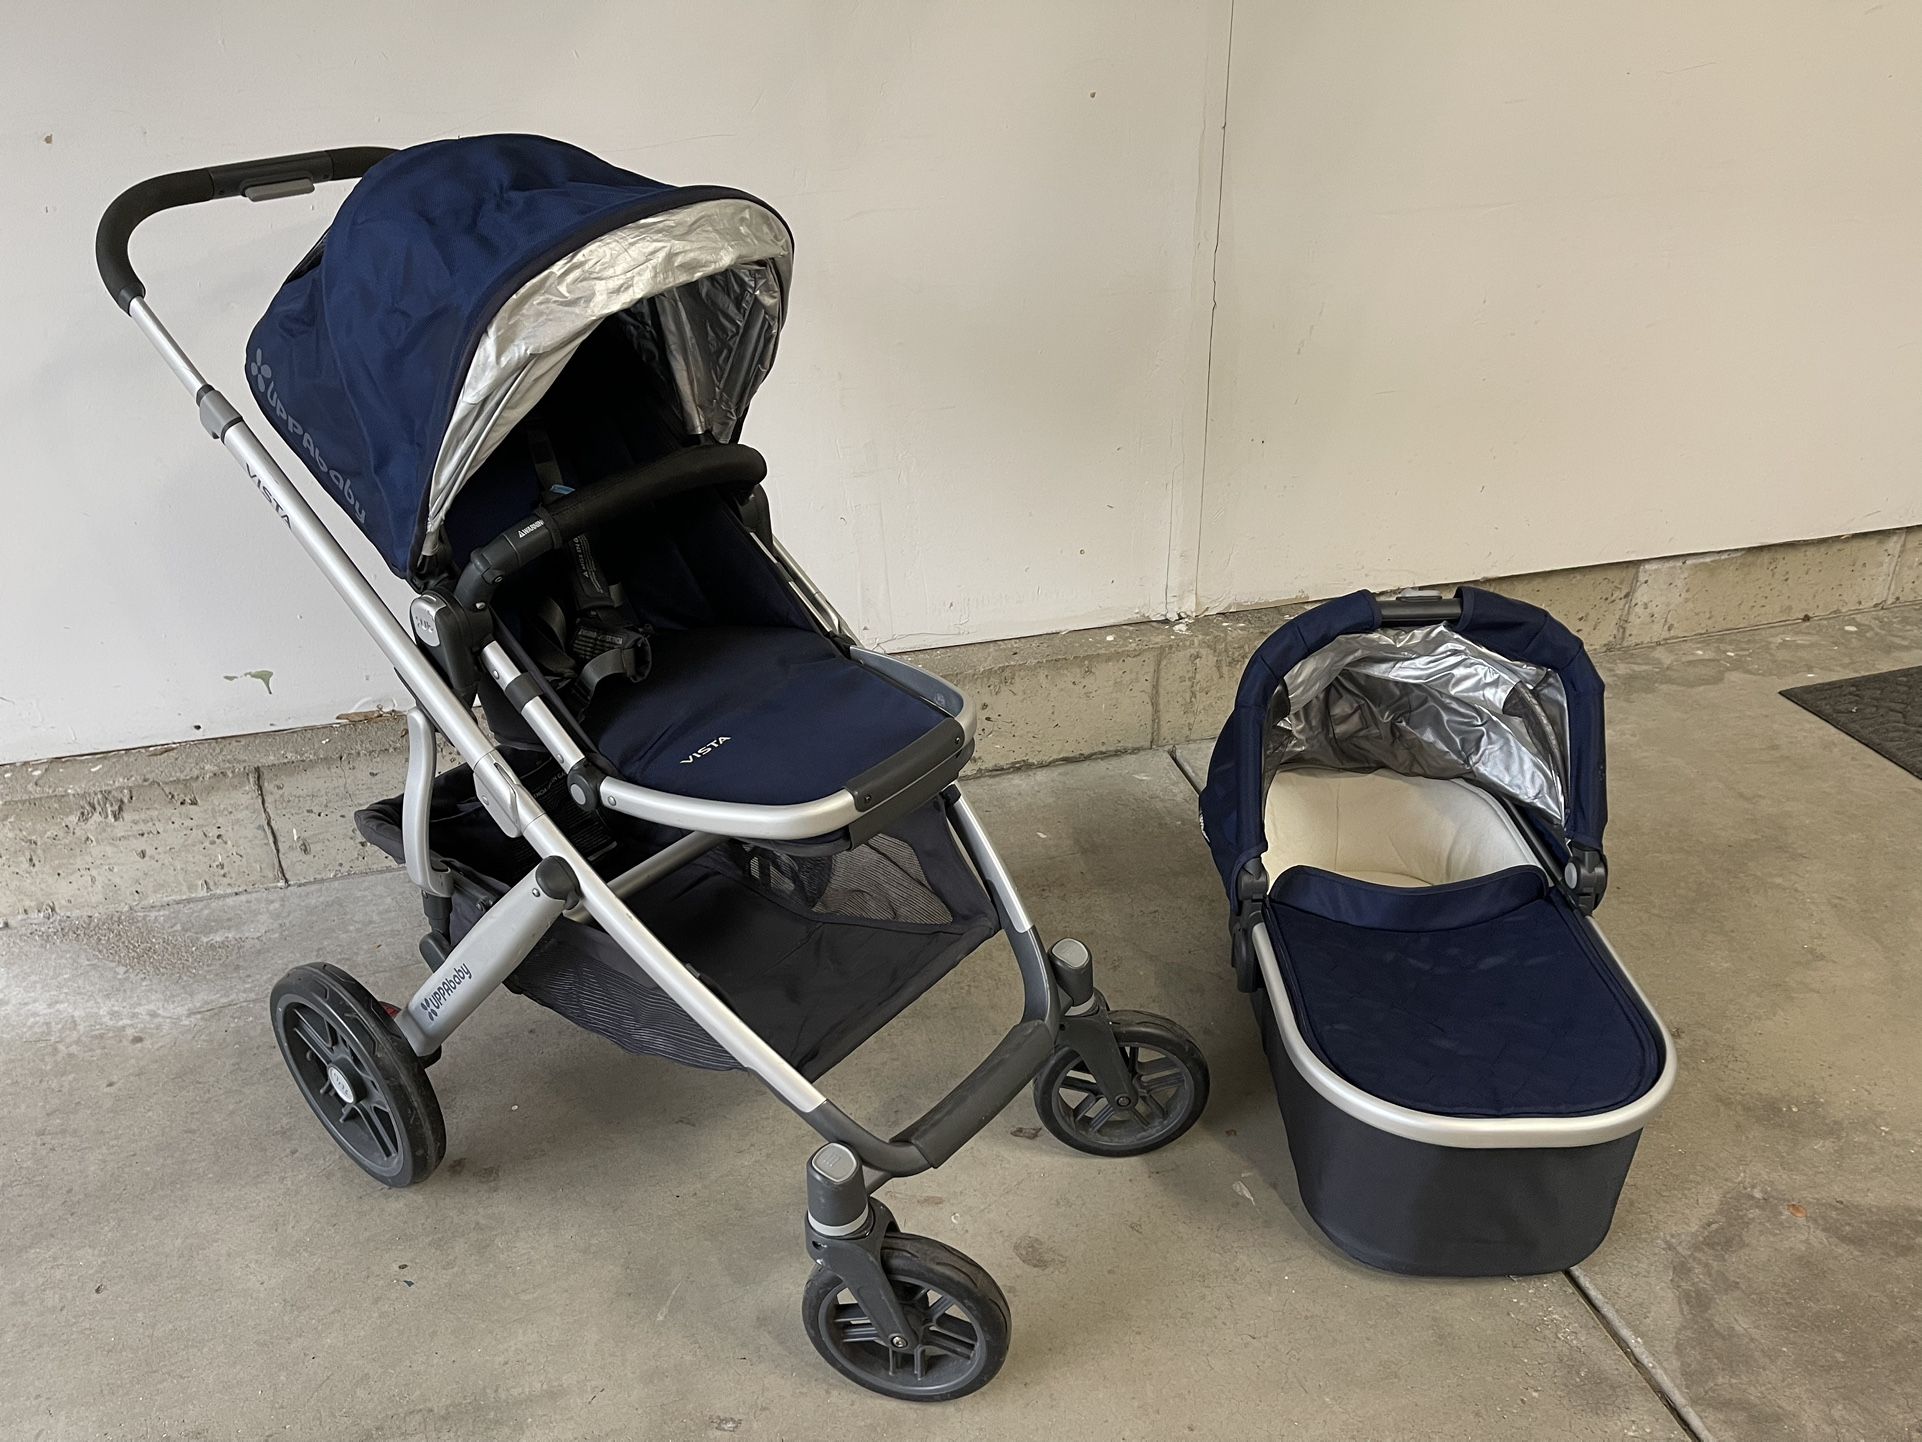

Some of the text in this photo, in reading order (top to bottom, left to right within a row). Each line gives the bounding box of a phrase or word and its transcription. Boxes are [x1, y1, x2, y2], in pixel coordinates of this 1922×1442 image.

[246, 463, 292, 529] VISTA
[680, 736, 732, 764] VISTA
[429, 963, 472, 1010] UPPAbaby
